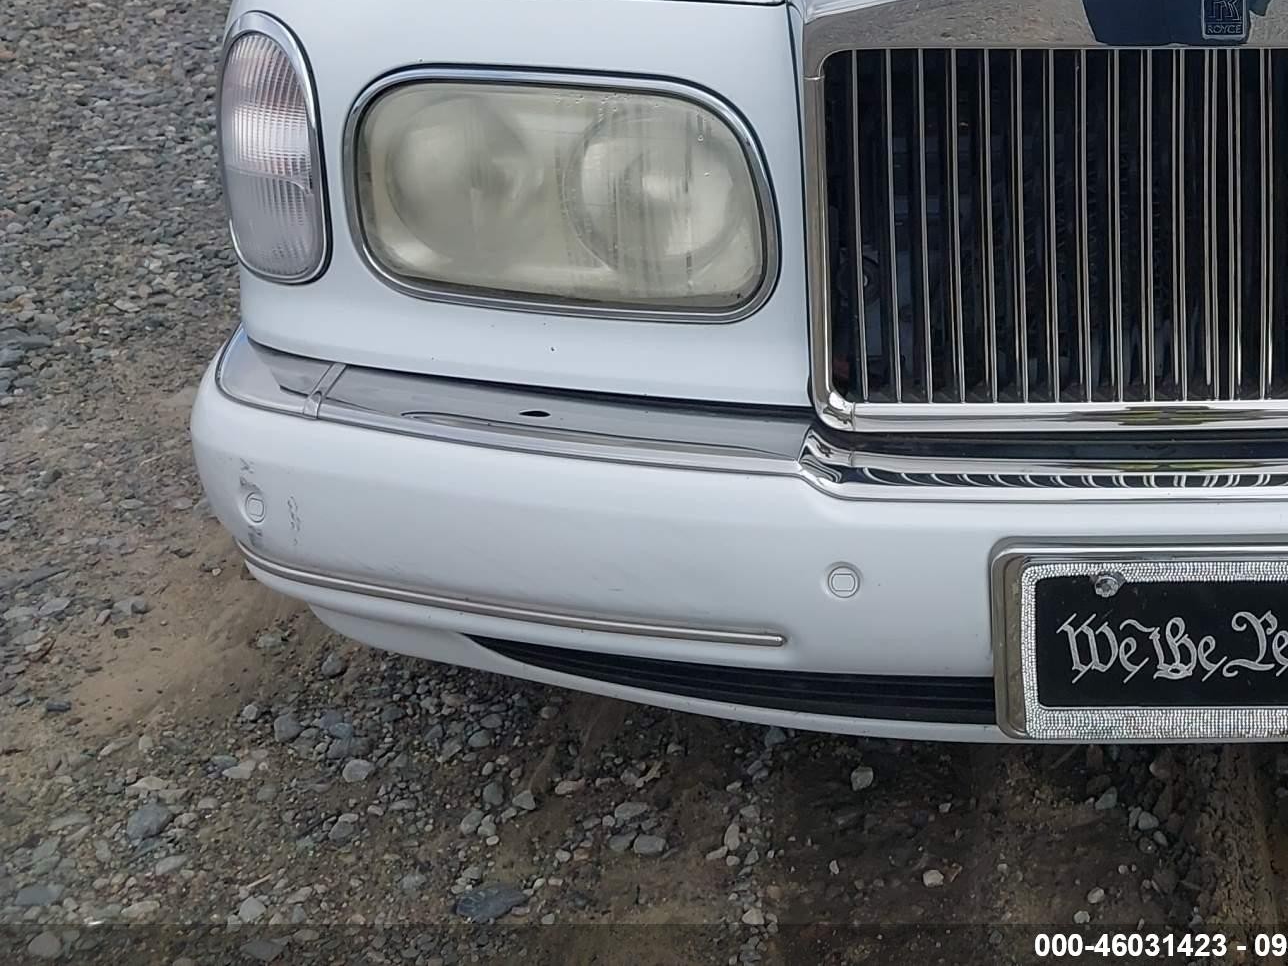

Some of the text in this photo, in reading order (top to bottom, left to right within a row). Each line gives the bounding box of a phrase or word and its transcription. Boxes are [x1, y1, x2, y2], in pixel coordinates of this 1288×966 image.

[1207, 24, 1242, 34] ROYCE
[1056, 613, 1150, 684] We
[1119, 617, 1228, 682] The
